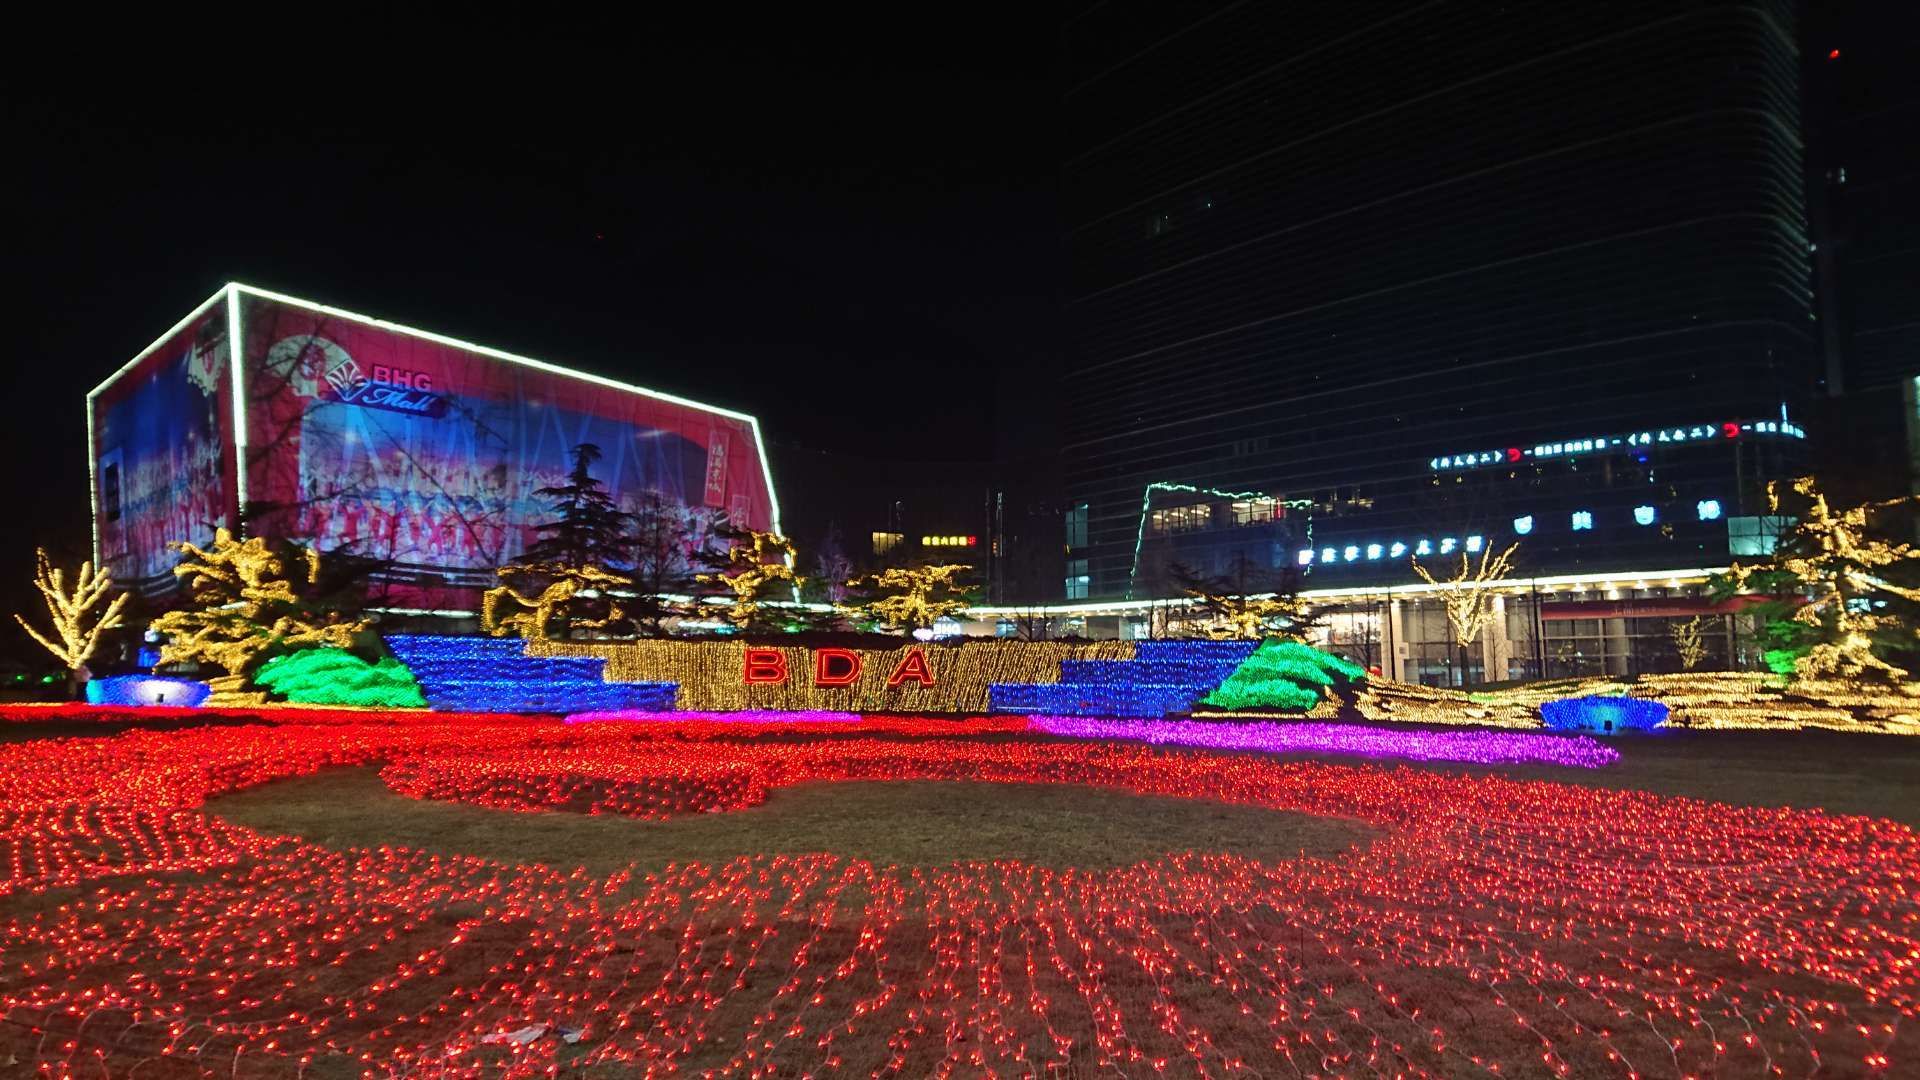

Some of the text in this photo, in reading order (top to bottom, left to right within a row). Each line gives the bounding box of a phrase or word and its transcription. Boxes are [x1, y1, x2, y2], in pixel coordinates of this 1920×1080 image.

[373, 365, 432, 393] BHG
[362, 388, 440, 411] Mall
[744, 648, 936, 687] BDA
